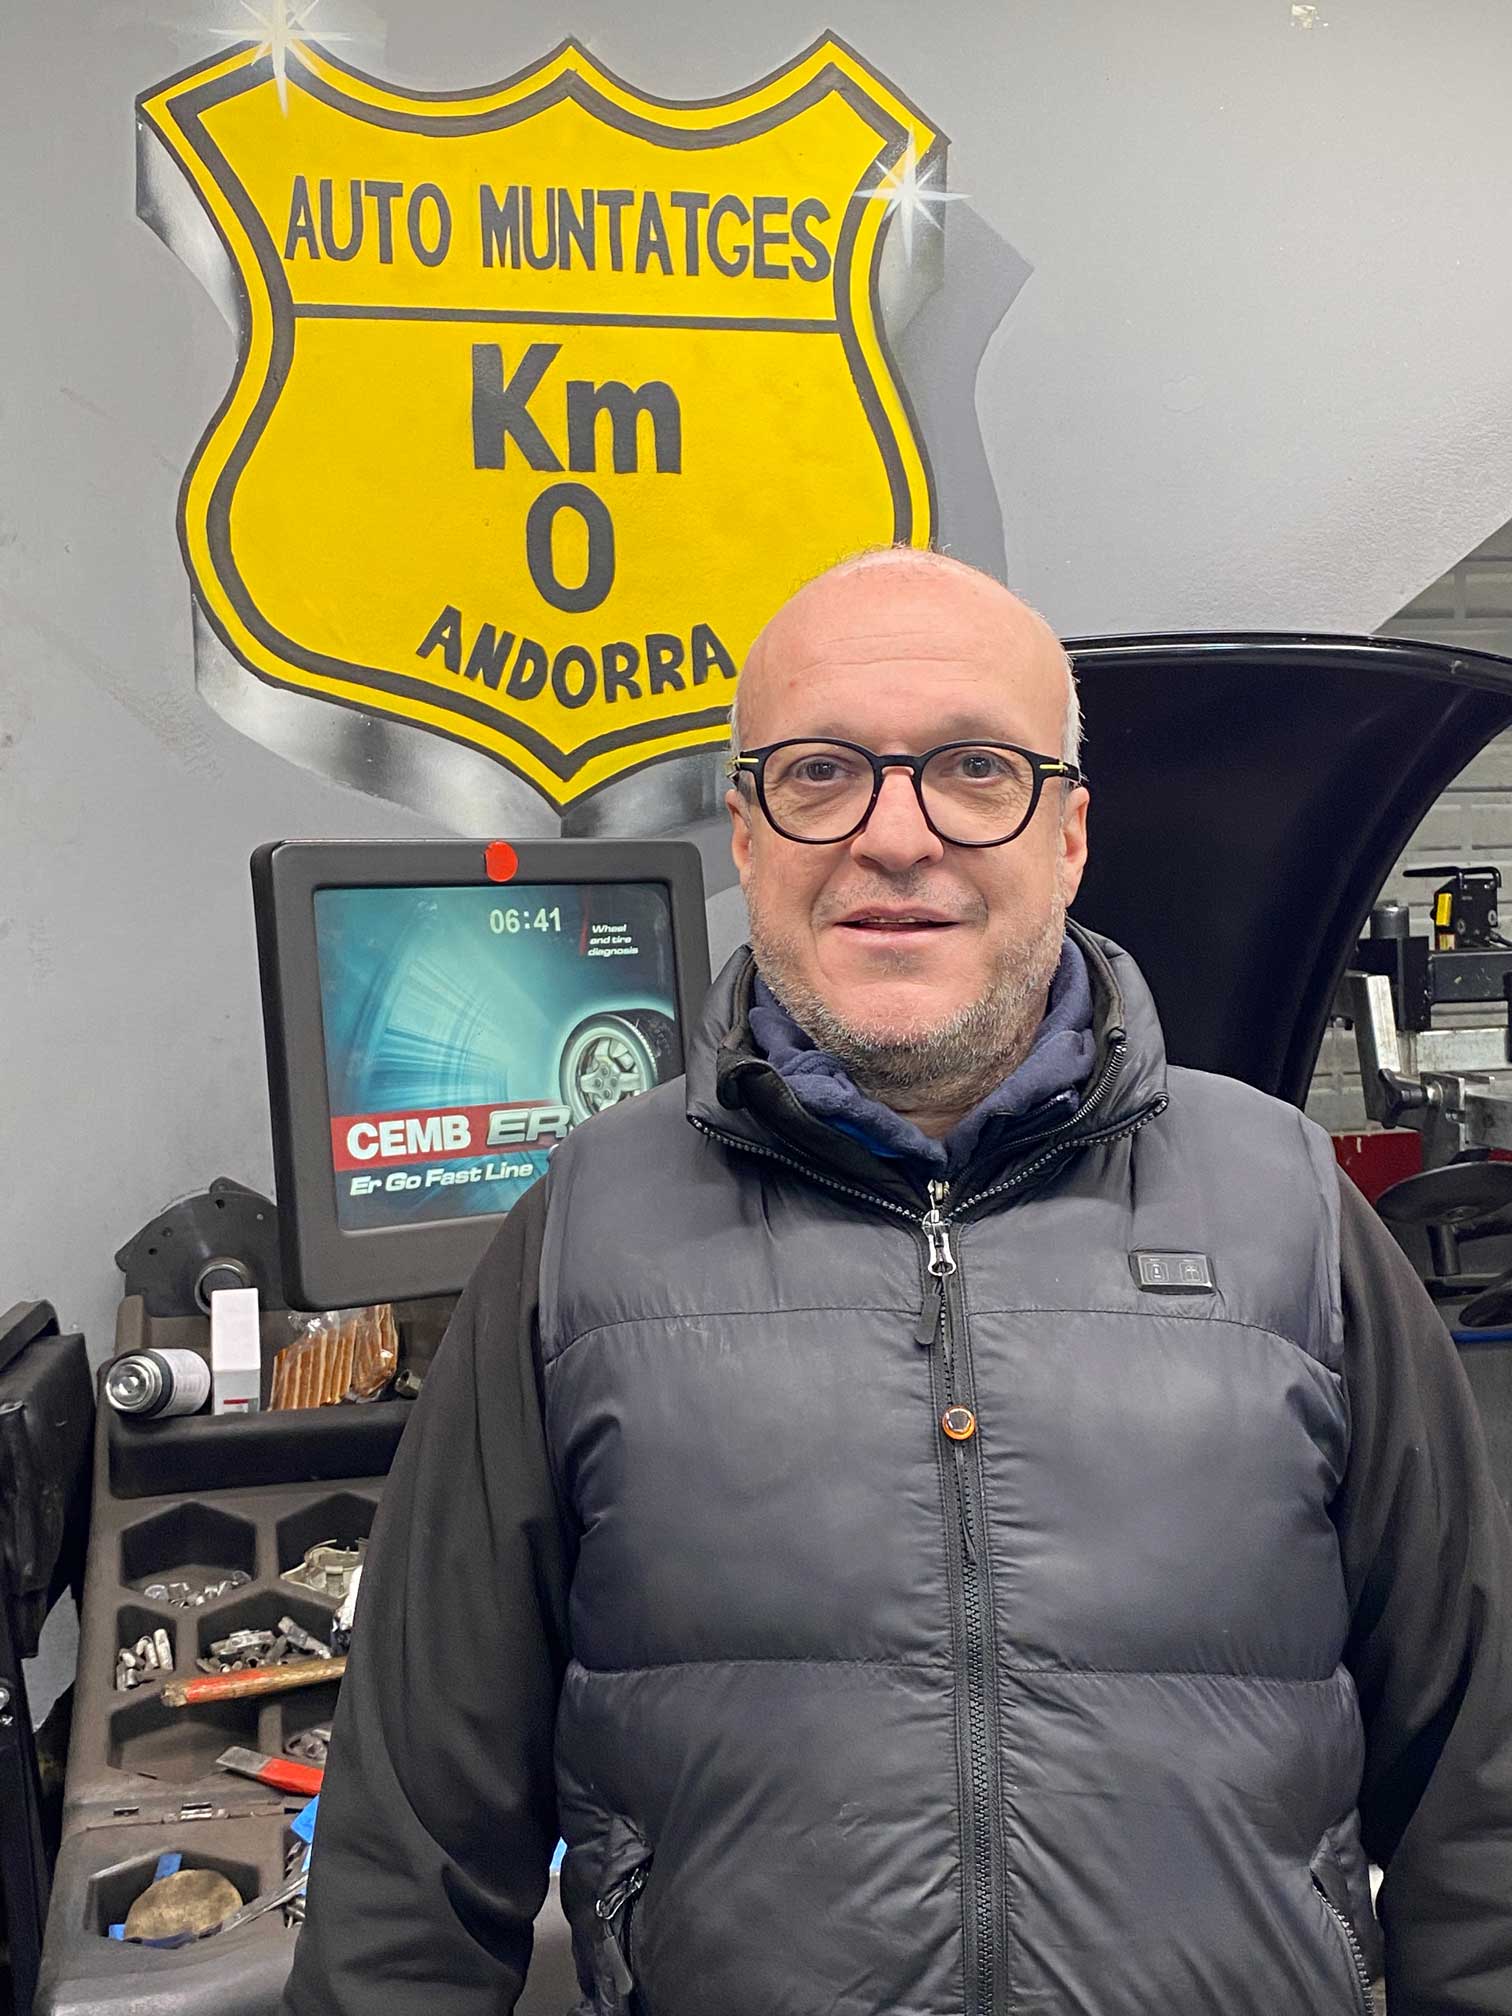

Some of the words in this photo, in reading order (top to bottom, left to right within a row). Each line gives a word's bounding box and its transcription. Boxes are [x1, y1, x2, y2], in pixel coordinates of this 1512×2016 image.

[284, 175, 452, 268] AUTO
[480, 184, 832, 283] MUNTATGES
[471, 343, 683, 475] Km
[416, 604, 737, 707] ANDORRA
[489, 907, 561, 934] 06:41
[591, 923, 627, 934] Wheel
[587, 946, 639, 958] diagnosis
[589, 935, 611, 945] and
[611, 935, 632, 944] tire
[346, 1115, 472, 1160] CEMB
[486, 1105, 574, 1146] ER
[349, 1175, 382, 1197] Er
[385, 1171, 422, 1193] Go
[424, 1166, 482, 1188] Fast
[484, 1161, 534, 1182] Line
